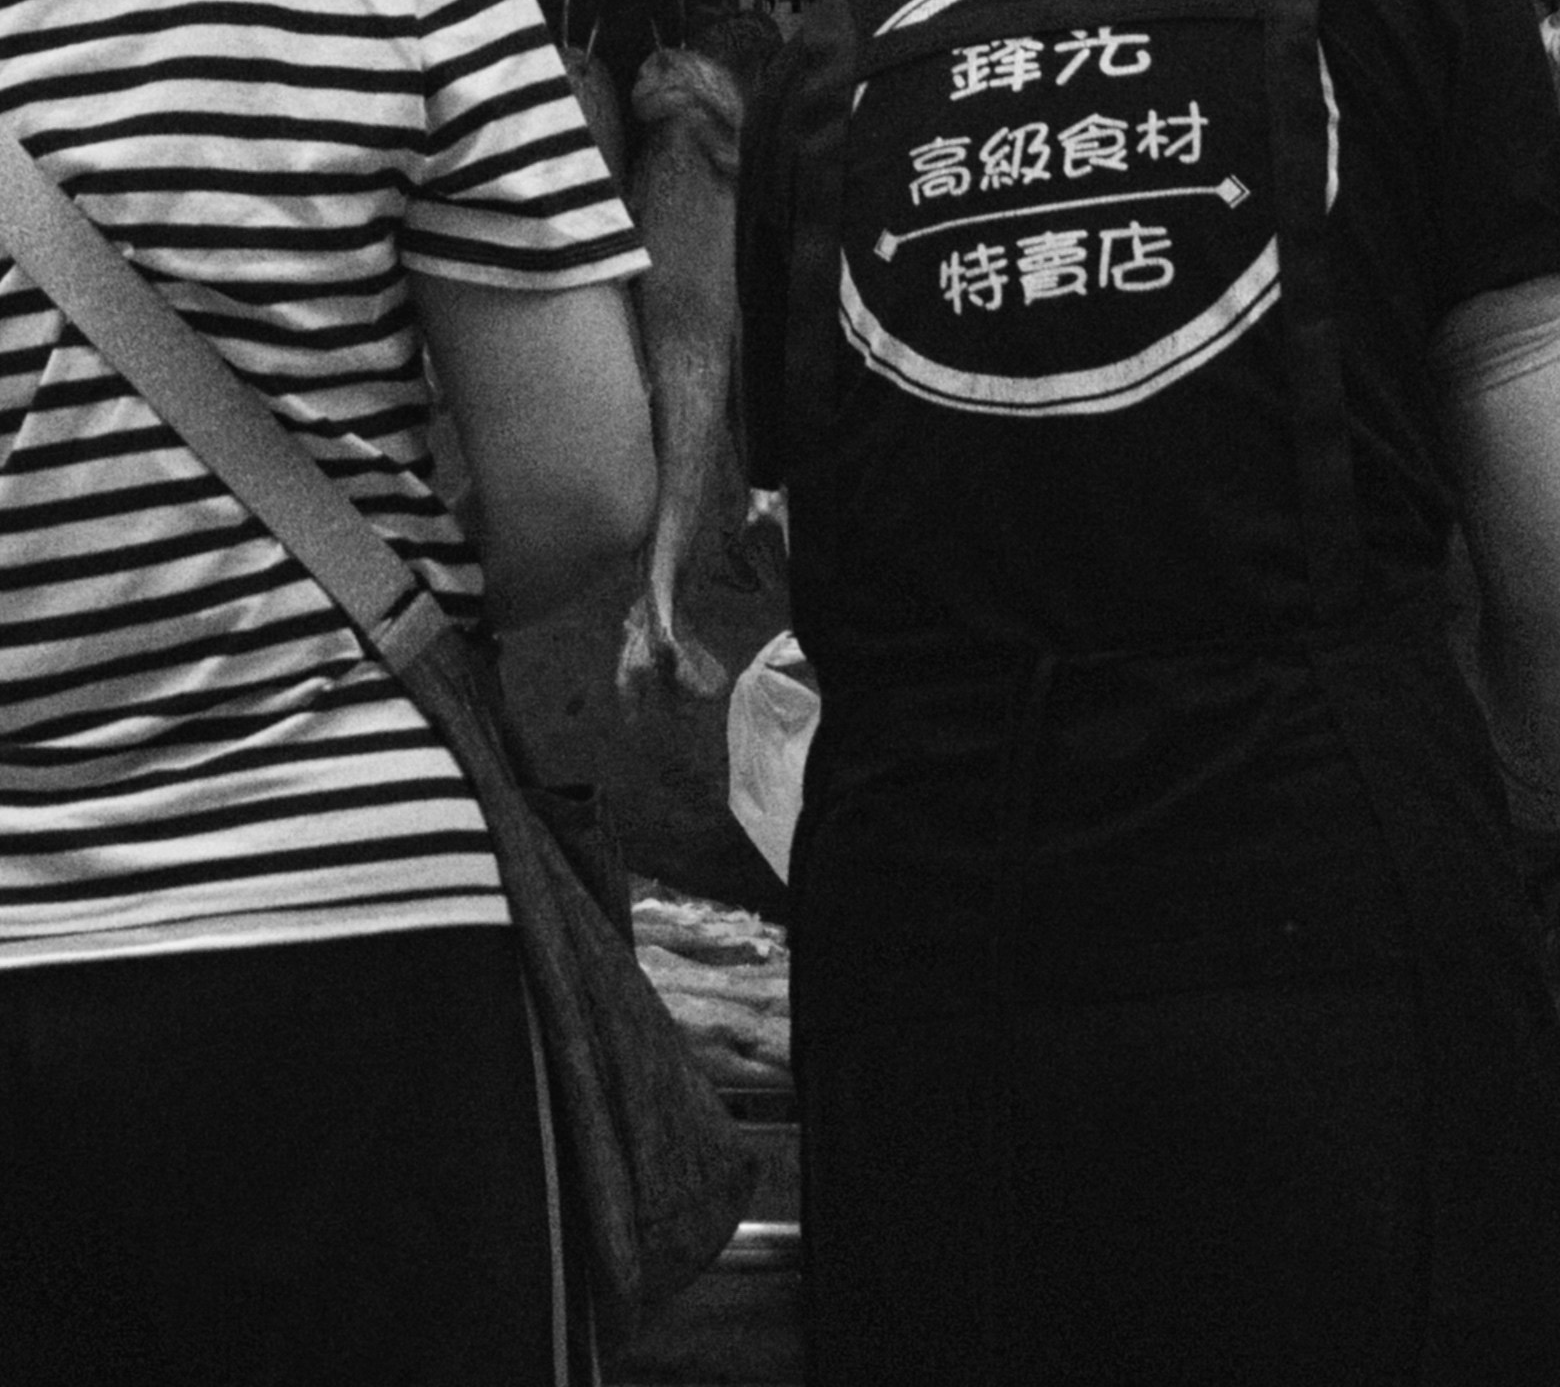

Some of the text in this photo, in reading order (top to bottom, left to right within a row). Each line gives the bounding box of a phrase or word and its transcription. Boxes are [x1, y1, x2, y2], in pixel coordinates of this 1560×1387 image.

[907, 99, 1210, 207] 高級食材
[938, 220, 1177, 316] 特賣店
